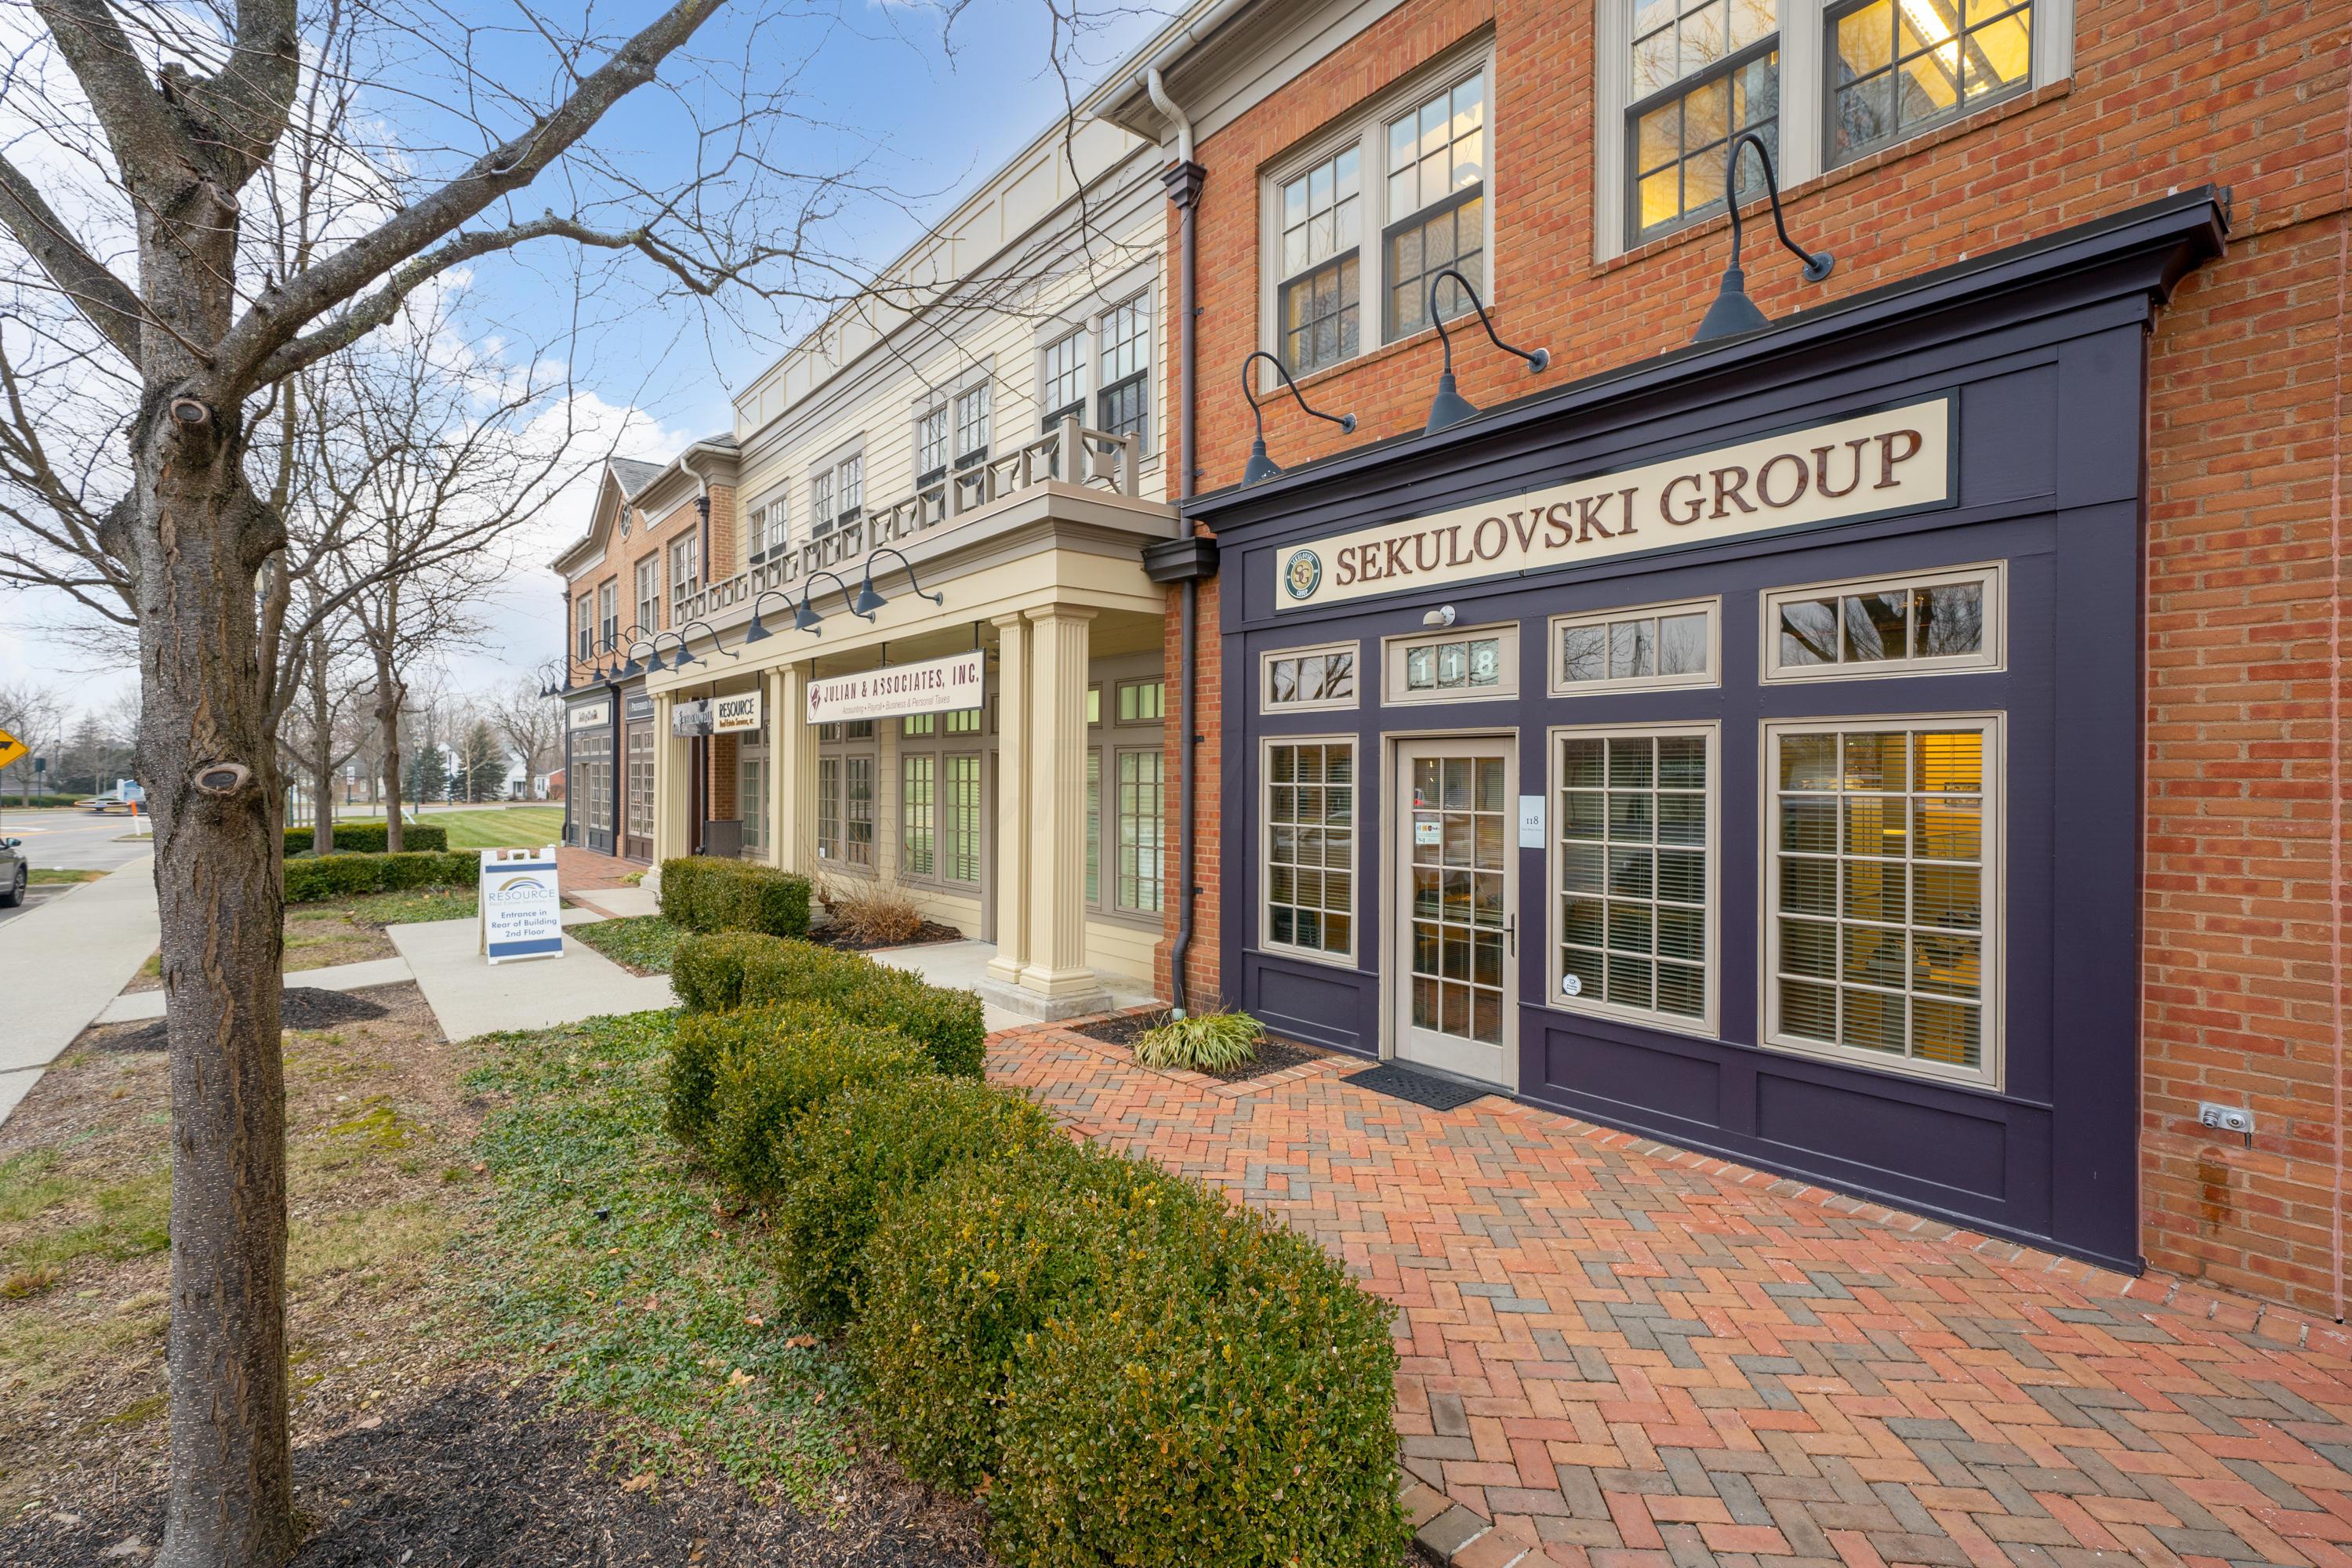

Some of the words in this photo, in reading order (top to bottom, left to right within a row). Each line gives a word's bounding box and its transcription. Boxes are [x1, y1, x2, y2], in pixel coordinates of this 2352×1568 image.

[1336, 487, 1639, 586] SEKULOVSKI
[1660, 429, 1922, 525] GROUP
[1417, 649, 1494, 681] 118
[824, 682, 856, 702] JULIAN
[862, 681, 867, 698] &
[873, 669, 946, 696] ASSOCIATES,
[953, 663, 979, 685] INC.
[719, 698, 754, 718] RESOURCE
[842, 706, 864, 715] Accounting
[867, 702, 882, 713] Payroll
[885, 701, 906, 710] Business
[912, 696, 935, 706] Personal
[935, 695, 951, 704] Taxes
[1526, 815, 1539, 825] 118
[488, 889, 555, 902] RESOURCE
